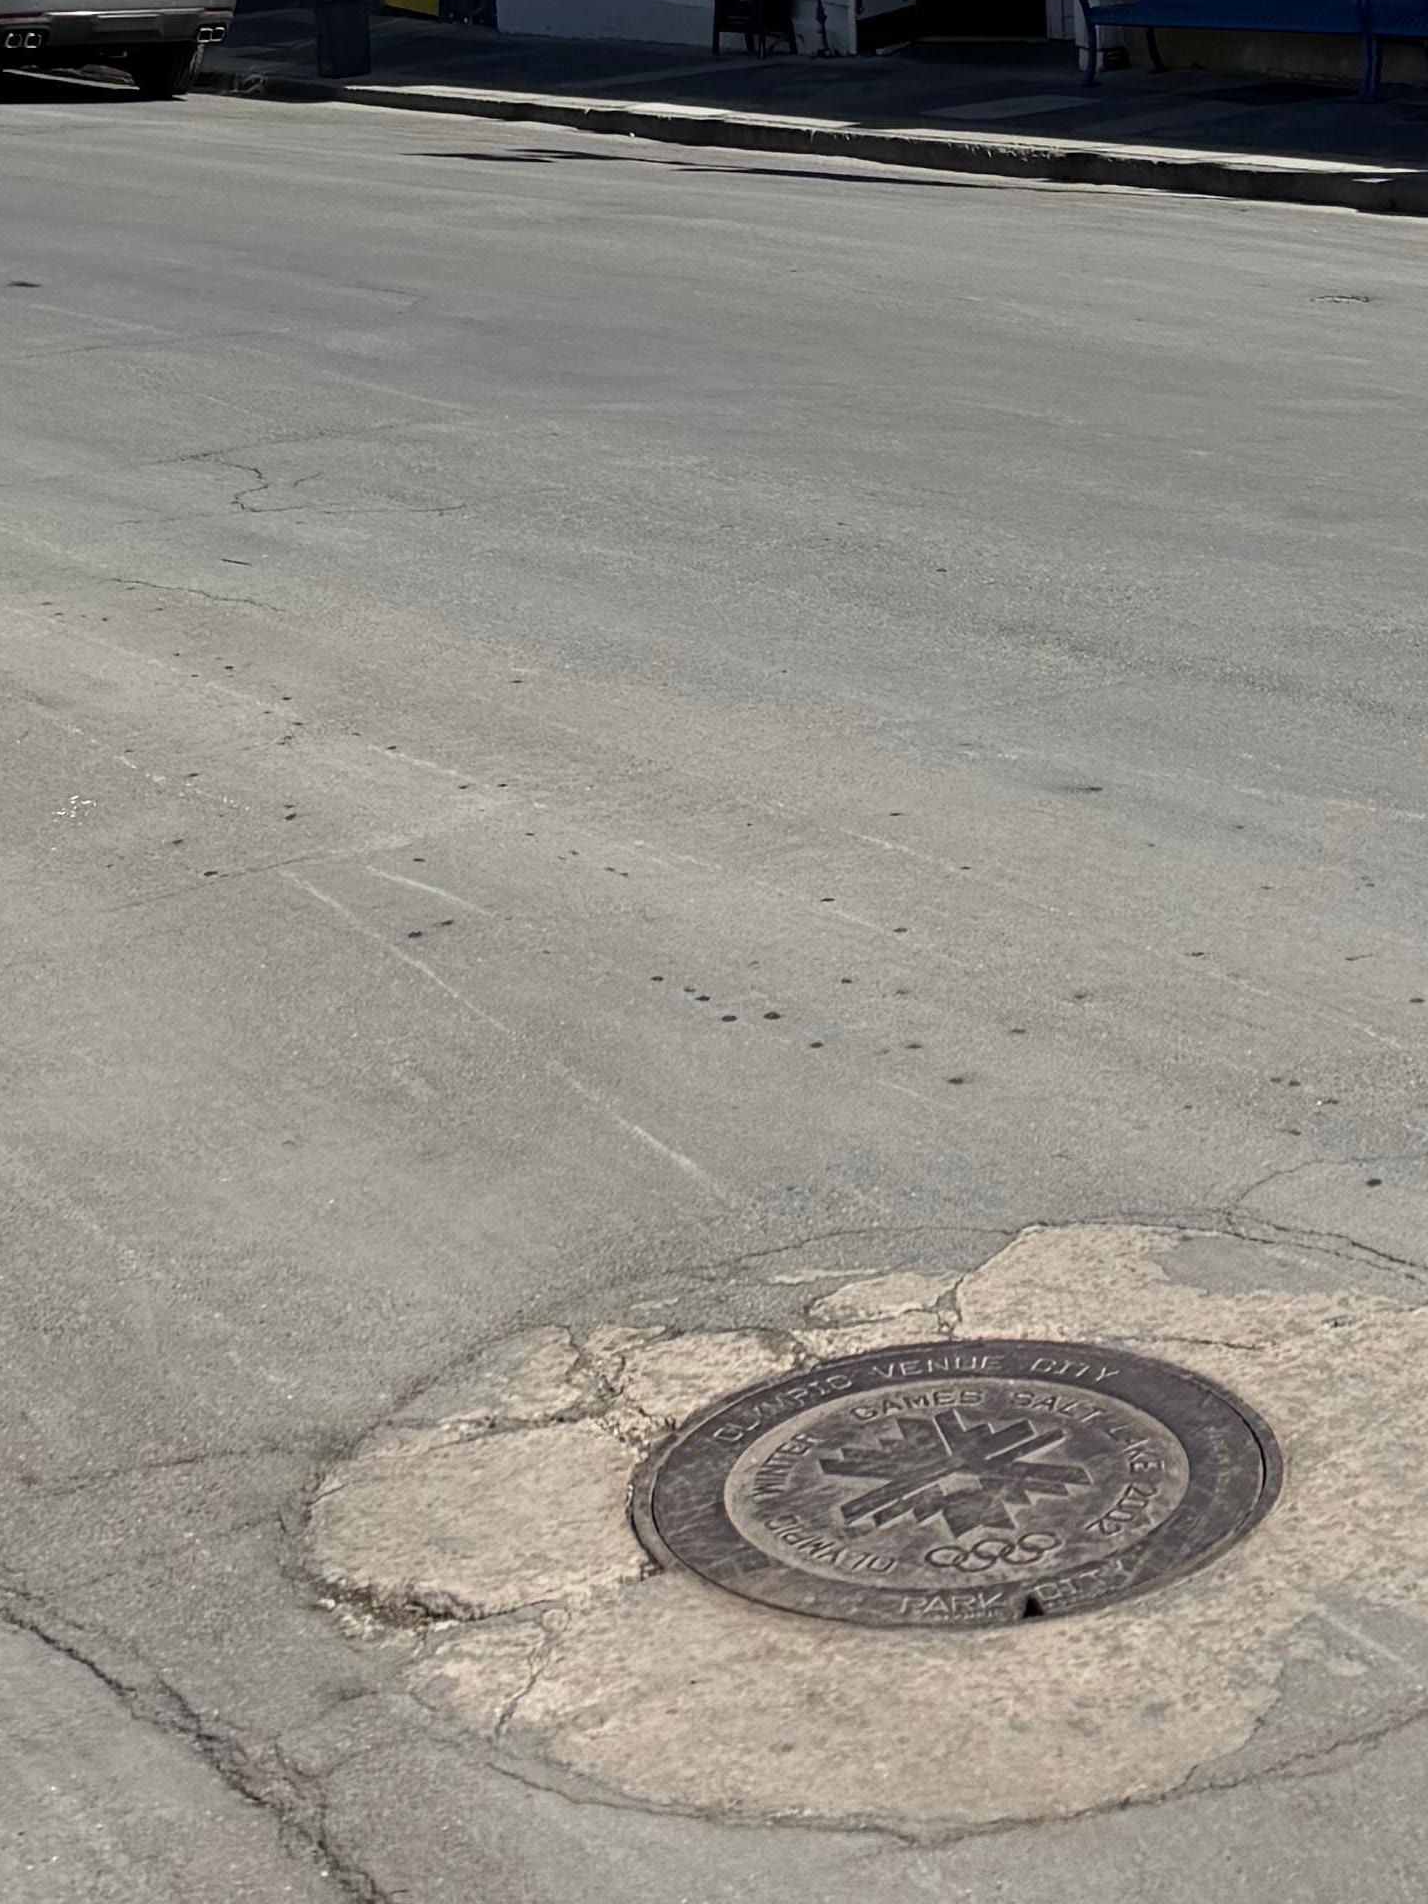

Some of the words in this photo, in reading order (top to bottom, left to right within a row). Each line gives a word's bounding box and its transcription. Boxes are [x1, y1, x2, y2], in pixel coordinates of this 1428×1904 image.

[873, 1355, 1005, 1378] VENUE
[1031, 1356, 1120, 1382] CITY
[851, 1391, 982, 1422] GAMES
[1011, 1392, 1102, 1423] SALT
[1085, 1482, 1160, 1535] 2002
[899, 1592, 1004, 1614] PARK
